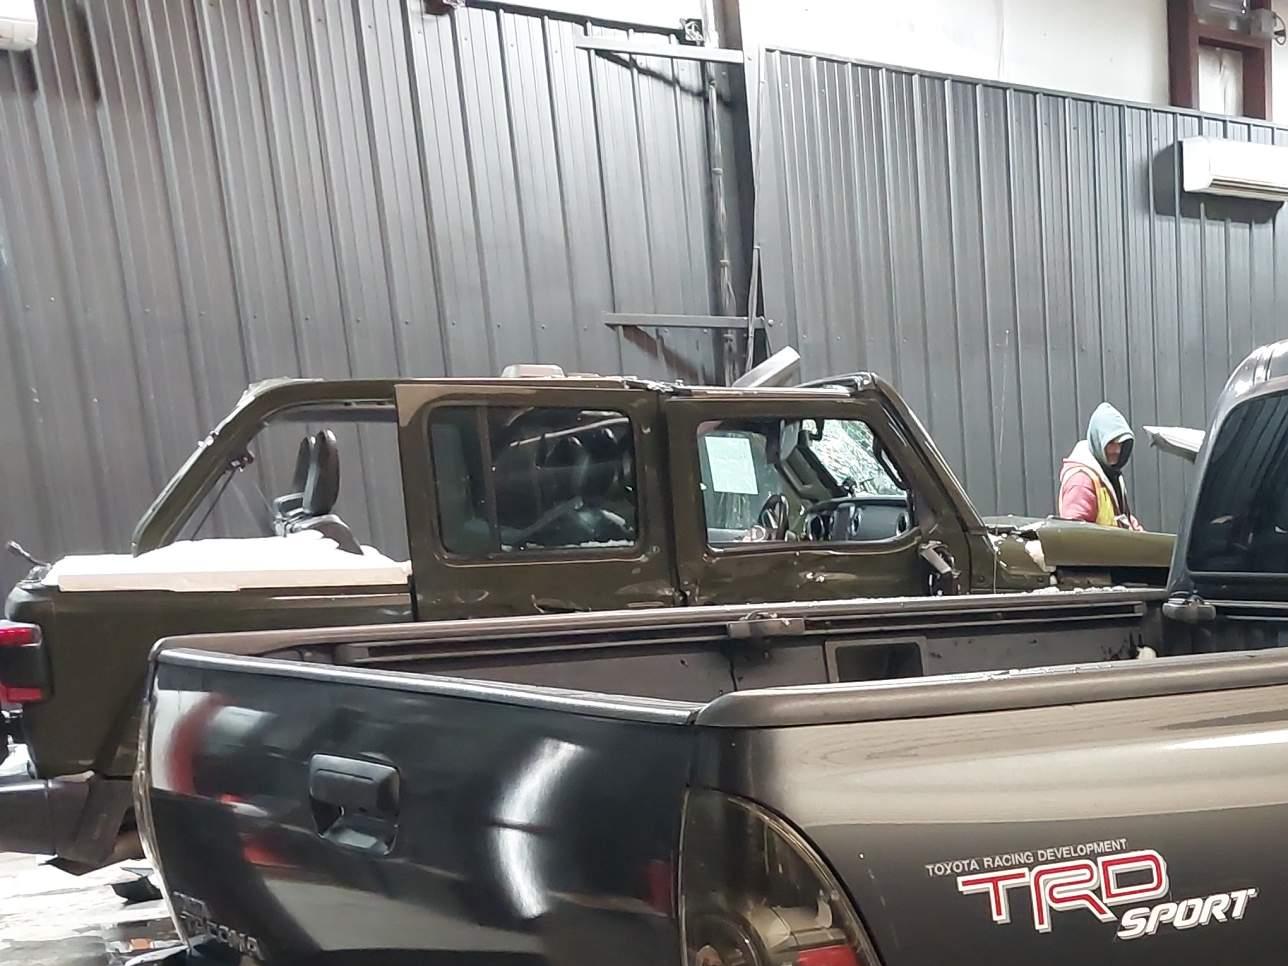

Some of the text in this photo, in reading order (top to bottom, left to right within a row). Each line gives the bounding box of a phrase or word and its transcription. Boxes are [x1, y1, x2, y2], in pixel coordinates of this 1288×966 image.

[925, 838, 1129, 877] TOYOTA RACING DEVELOPMENT
[957, 849, 1171, 933] TRD
[1116, 887, 1260, 941] SPORT
